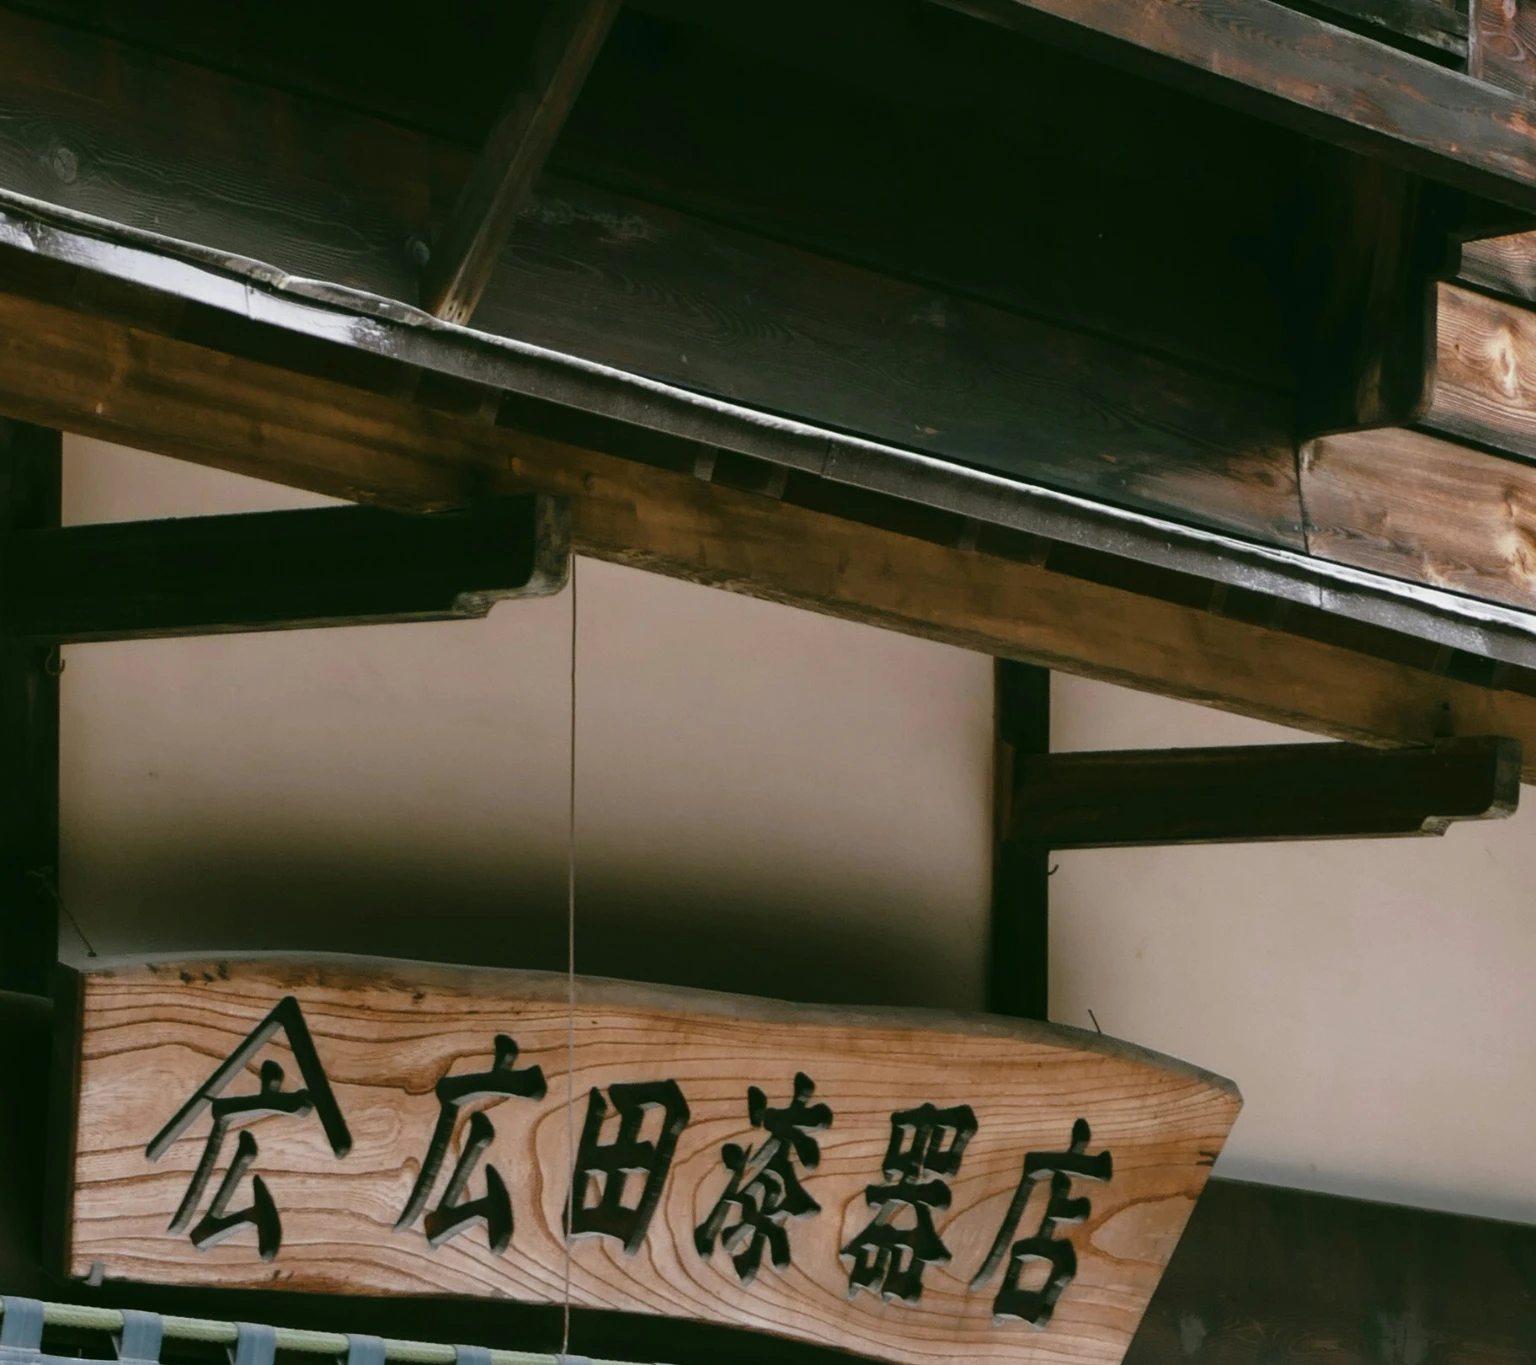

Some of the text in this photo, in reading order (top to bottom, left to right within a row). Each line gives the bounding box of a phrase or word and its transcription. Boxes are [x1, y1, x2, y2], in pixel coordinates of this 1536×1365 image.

[394, 1032, 1115, 1329] 広田漆器店
